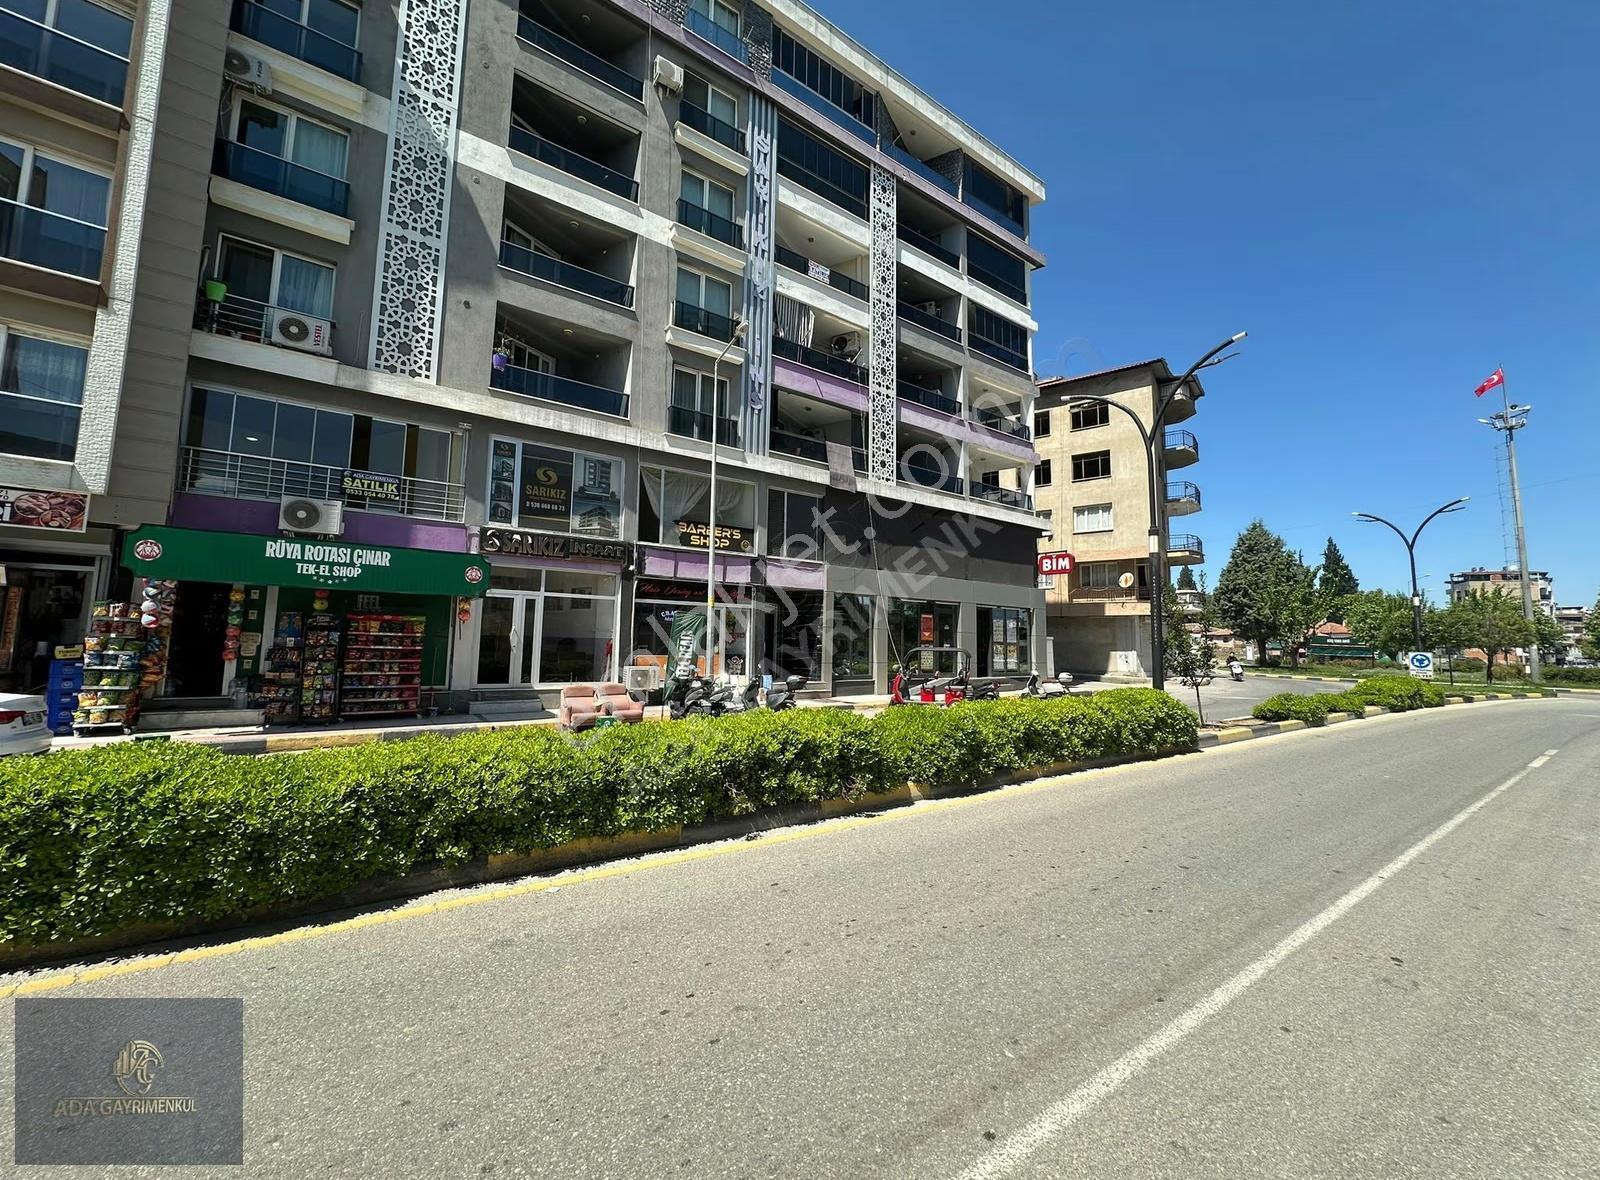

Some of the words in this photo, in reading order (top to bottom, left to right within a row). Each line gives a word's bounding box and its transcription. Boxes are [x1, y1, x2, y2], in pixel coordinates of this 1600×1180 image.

[343, 477, 398, 492] SATILIK
[526, 484, 567, 500] SARIKIZ
[502, 532, 565, 557] SARIKIZ
[265, 539, 301, 560] RÜYA
[304, 544, 350, 564] ROTASI
[353, 548, 391, 567] ÇINAR
[296, 562, 331, 576] TEK-EL
[332, 565, 362, 578] SHOP
